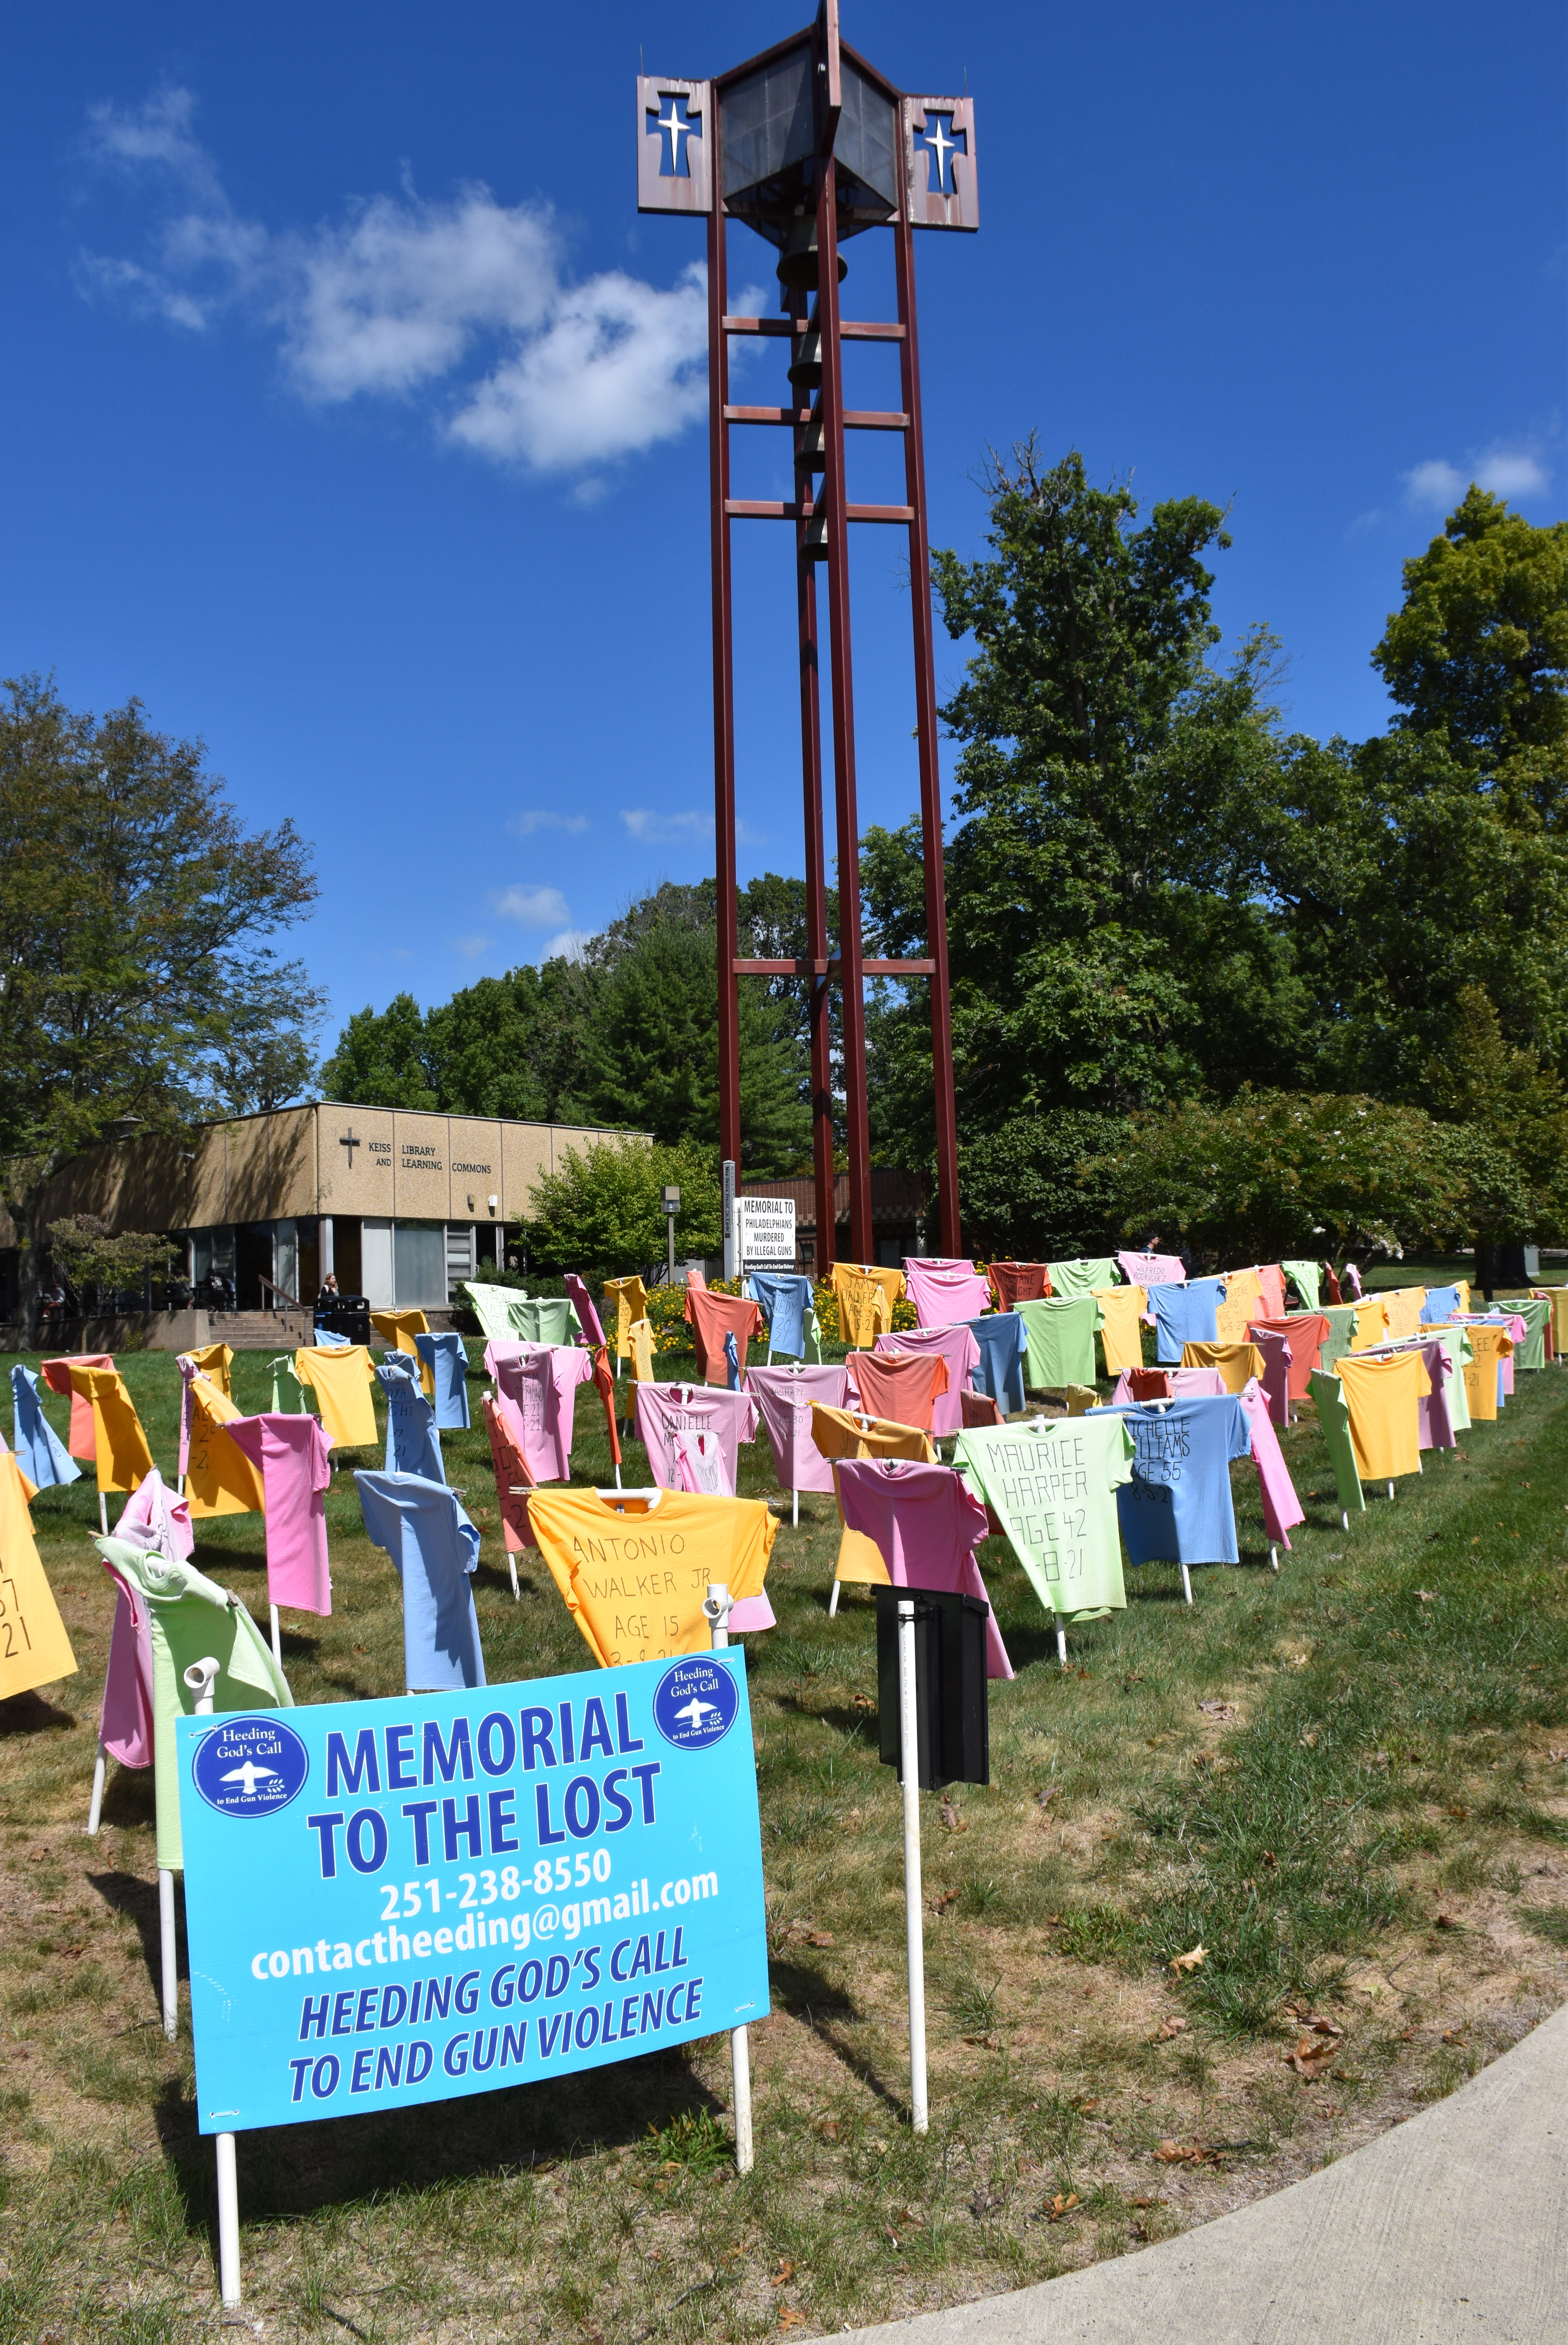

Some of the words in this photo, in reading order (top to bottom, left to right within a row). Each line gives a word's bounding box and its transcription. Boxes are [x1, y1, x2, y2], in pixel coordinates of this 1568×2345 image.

[369, 1142, 391, 1153] KEISS
[402, 1145, 436, 1156] LIBRARY
[376, 1158, 391, 1166] AND
[402, 1159, 442, 1170] LEARNING
[452, 1163, 491, 1174] COMMONS
[744, 1200, 782, 1213] MEMORIAL
[785, 1202, 793, 1214] TO
[746, 1219, 792, 1229] PHILADELPHIANS
[754, 1232, 784, 1242] MURDERED
[747, 1246, 753, 1255] BY
[755, 1246, 776, 1256] ILLEGAL
[778, 1246, 792, 1255] GUNS
[1134, 1272, 1166, 1282] RODRIGUEZ
[1136, 1265, 1165, 1274] WILFREDO
[477, 1289, 511, 1303] ANTHONY
[849, 1304, 864, 1317] AGE
[776, 1318, 791, 1333] 20
[771, 1387, 803, 1396] JASHAN
[661, 1414, 712, 1430] DANIELLE
[986, 1438, 1085, 1472] MAURICE
[1161, 1461, 1183, 1481] 55
[1002, 1471, 1087, 1508] HARPER
[1010, 1512, 1059, 1545] AGE
[1063, 1508, 1087, 1538] 42
[574, 1534, 684, 1563] ANTONIO
[583, 1572, 677, 1599] WALKER
[691, 1568, 711, 1588] JR
[615, 1615, 650, 1639] AGE
[664, 1615, 679, 1636] 15
[674, 1667, 713, 1682] Heeding
[671, 1683, 697, 1697] God's
[700, 1678, 719, 1692] Call
[222, 1728, 275, 1742] Heeding
[703, 1725, 724, 1733] Violence
[217, 1744, 252, 1758] God's
[256, 1741, 282, 1755] Call
[326, 1691, 644, 1798] MEMORIAL
[258, 1793, 287, 1801] Violence
[307, 1808, 388, 1879] TO
[401, 1788, 520, 1867] THE
[535, 1761, 662, 1847] LOST
[380, 1848, 611, 1920] 251-238-8550
[252, 1871, 719, 1980] contactheeding@gmail.com
[298, 1970, 481, 2041] HEEDING
[490, 1946, 601, 2009] GOD'S
[610, 1925, 688, 1984] CALL
[289, 2054, 340, 2104] TO
[350, 2040, 434, 2095] END
[443, 2020, 528, 2077] GUN
[537, 1977, 704, 2059] VIOLENCE
